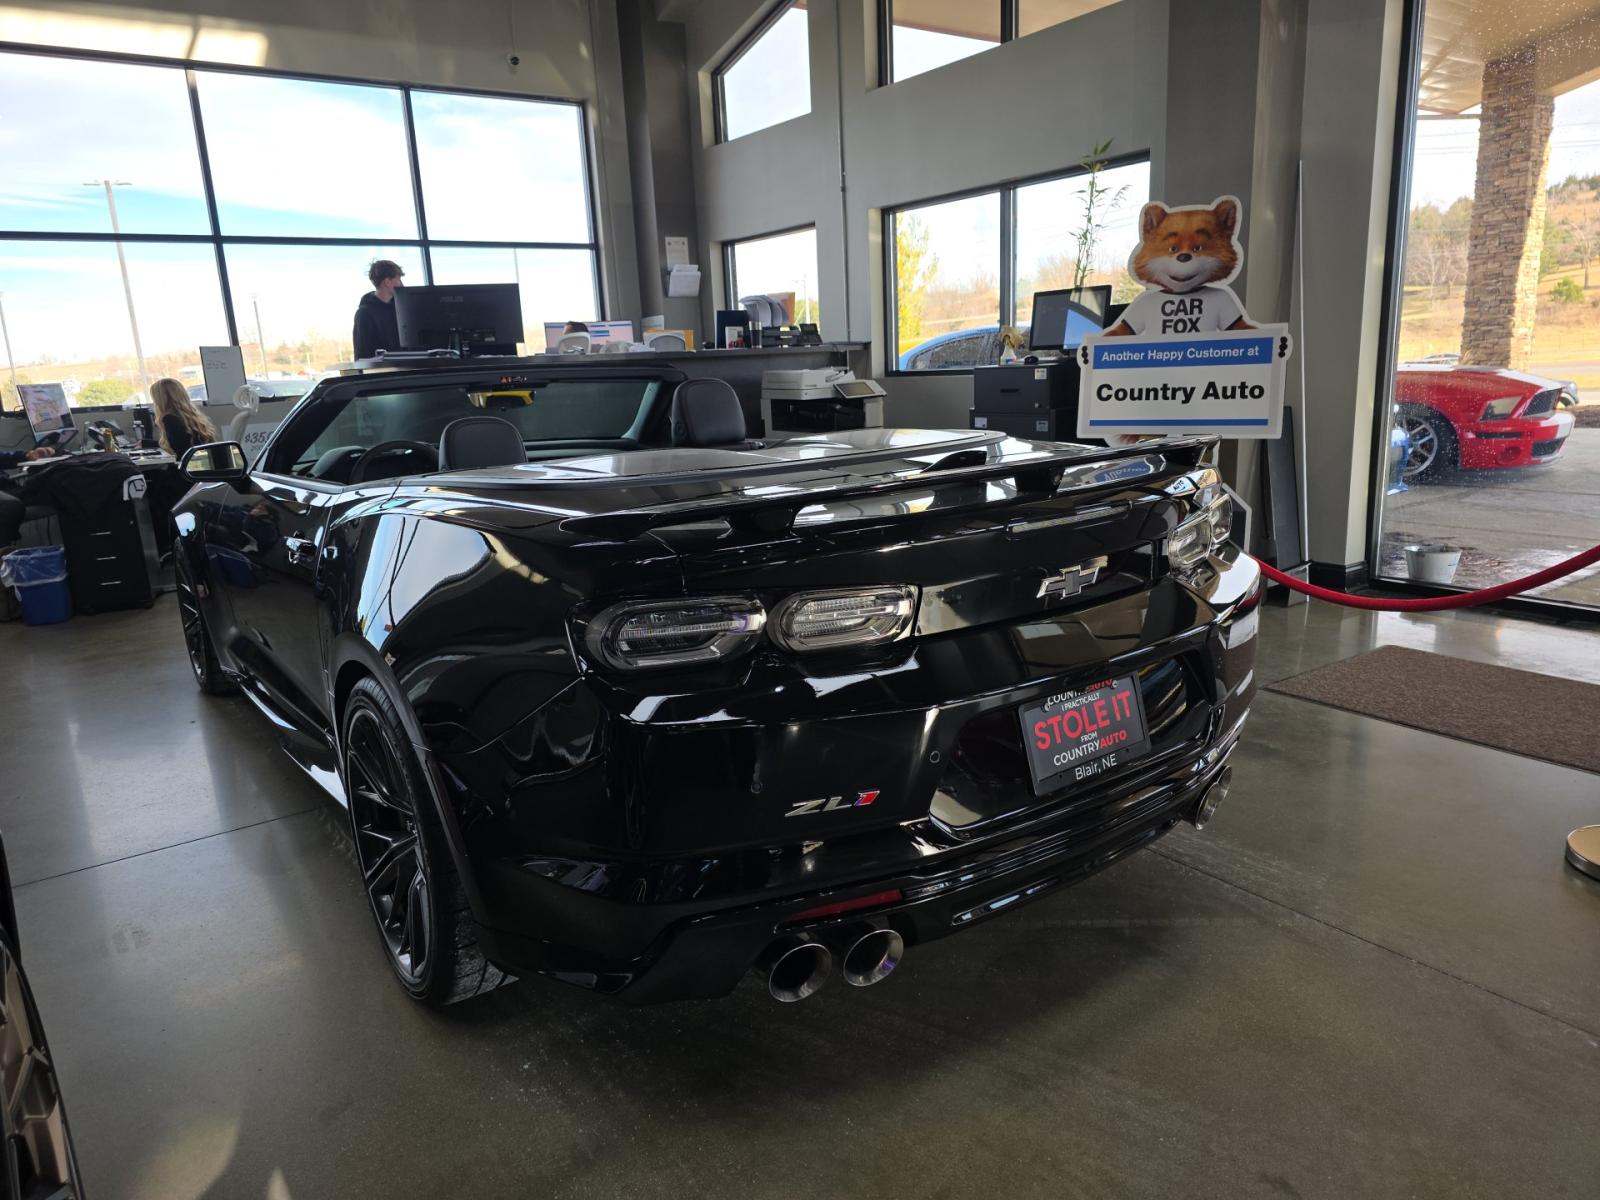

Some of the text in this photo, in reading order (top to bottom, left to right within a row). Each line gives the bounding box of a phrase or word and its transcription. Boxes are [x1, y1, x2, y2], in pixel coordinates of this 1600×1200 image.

[1161, 298, 1203, 317] CAR
[1161, 317, 1201, 334] FOX
[1101, 345, 1259, 362] Another Happy Customer at
[1096, 381, 1265, 404] Country Auto
[1064, 692, 1100, 711] PRACTICALLY
[1033, 690, 1132, 751] STOLE IT
[1080, 731, 1098, 743] FROM
[1074, 753, 1118, 781] Blair, NE
[784, 789, 881, 818] ZL1
